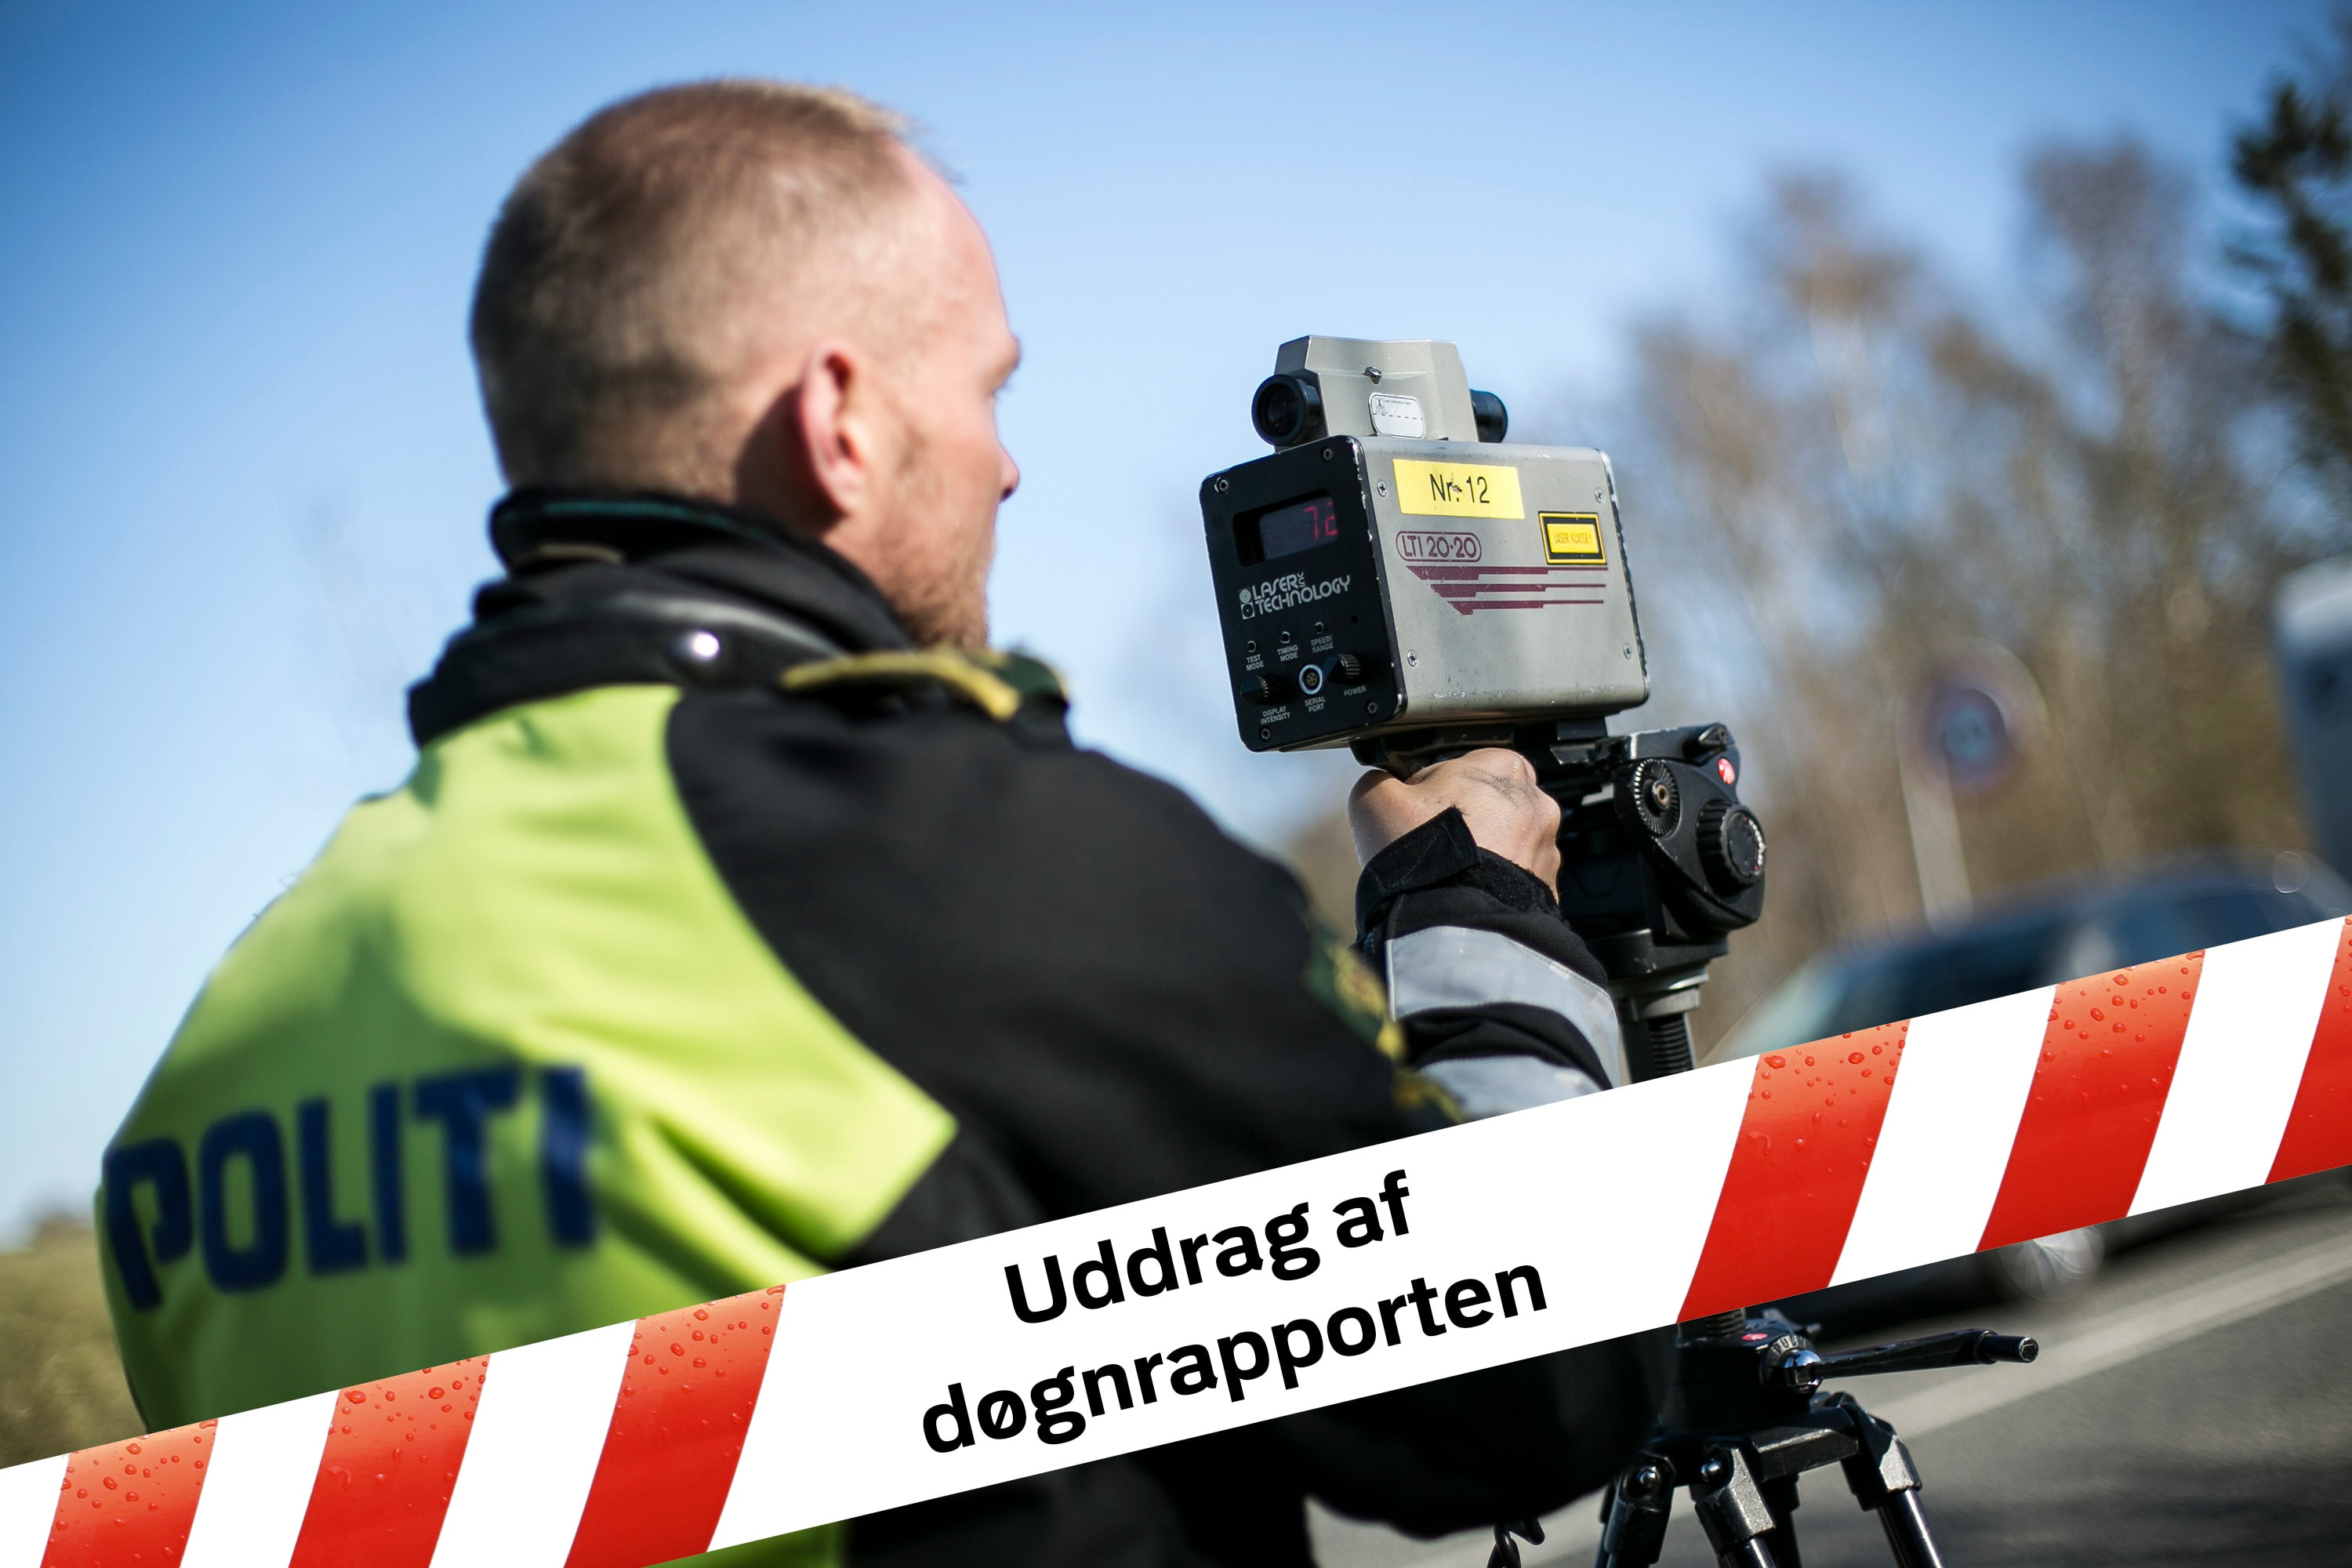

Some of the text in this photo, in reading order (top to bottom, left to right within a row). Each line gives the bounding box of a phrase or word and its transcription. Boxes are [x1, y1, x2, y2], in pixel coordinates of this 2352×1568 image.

[1429, 474, 1490, 503] Nr. 12
[1554, 532, 1570, 543] LASER
[1401, 535, 1424, 557] LTI
[1252, 574, 1299, 601] LASER
[1276, 644, 1298, 655] TIMING
[1312, 642, 1334, 653] RANGE
[1246, 654, 1261, 664] TEST
[1280, 652, 1298, 662] MODE
[1246, 660, 1265, 672] MODE
[1343, 685, 1367, 697] POWER
[1305, 695, 1326, 707] SERIAL
[1262, 706, 1287, 718] DISPLAY
[1308, 702, 1325, 713] PORT
[1260, 712, 1290, 725] INTENSITY
[102, 1060, 597, 1311] POLITI
